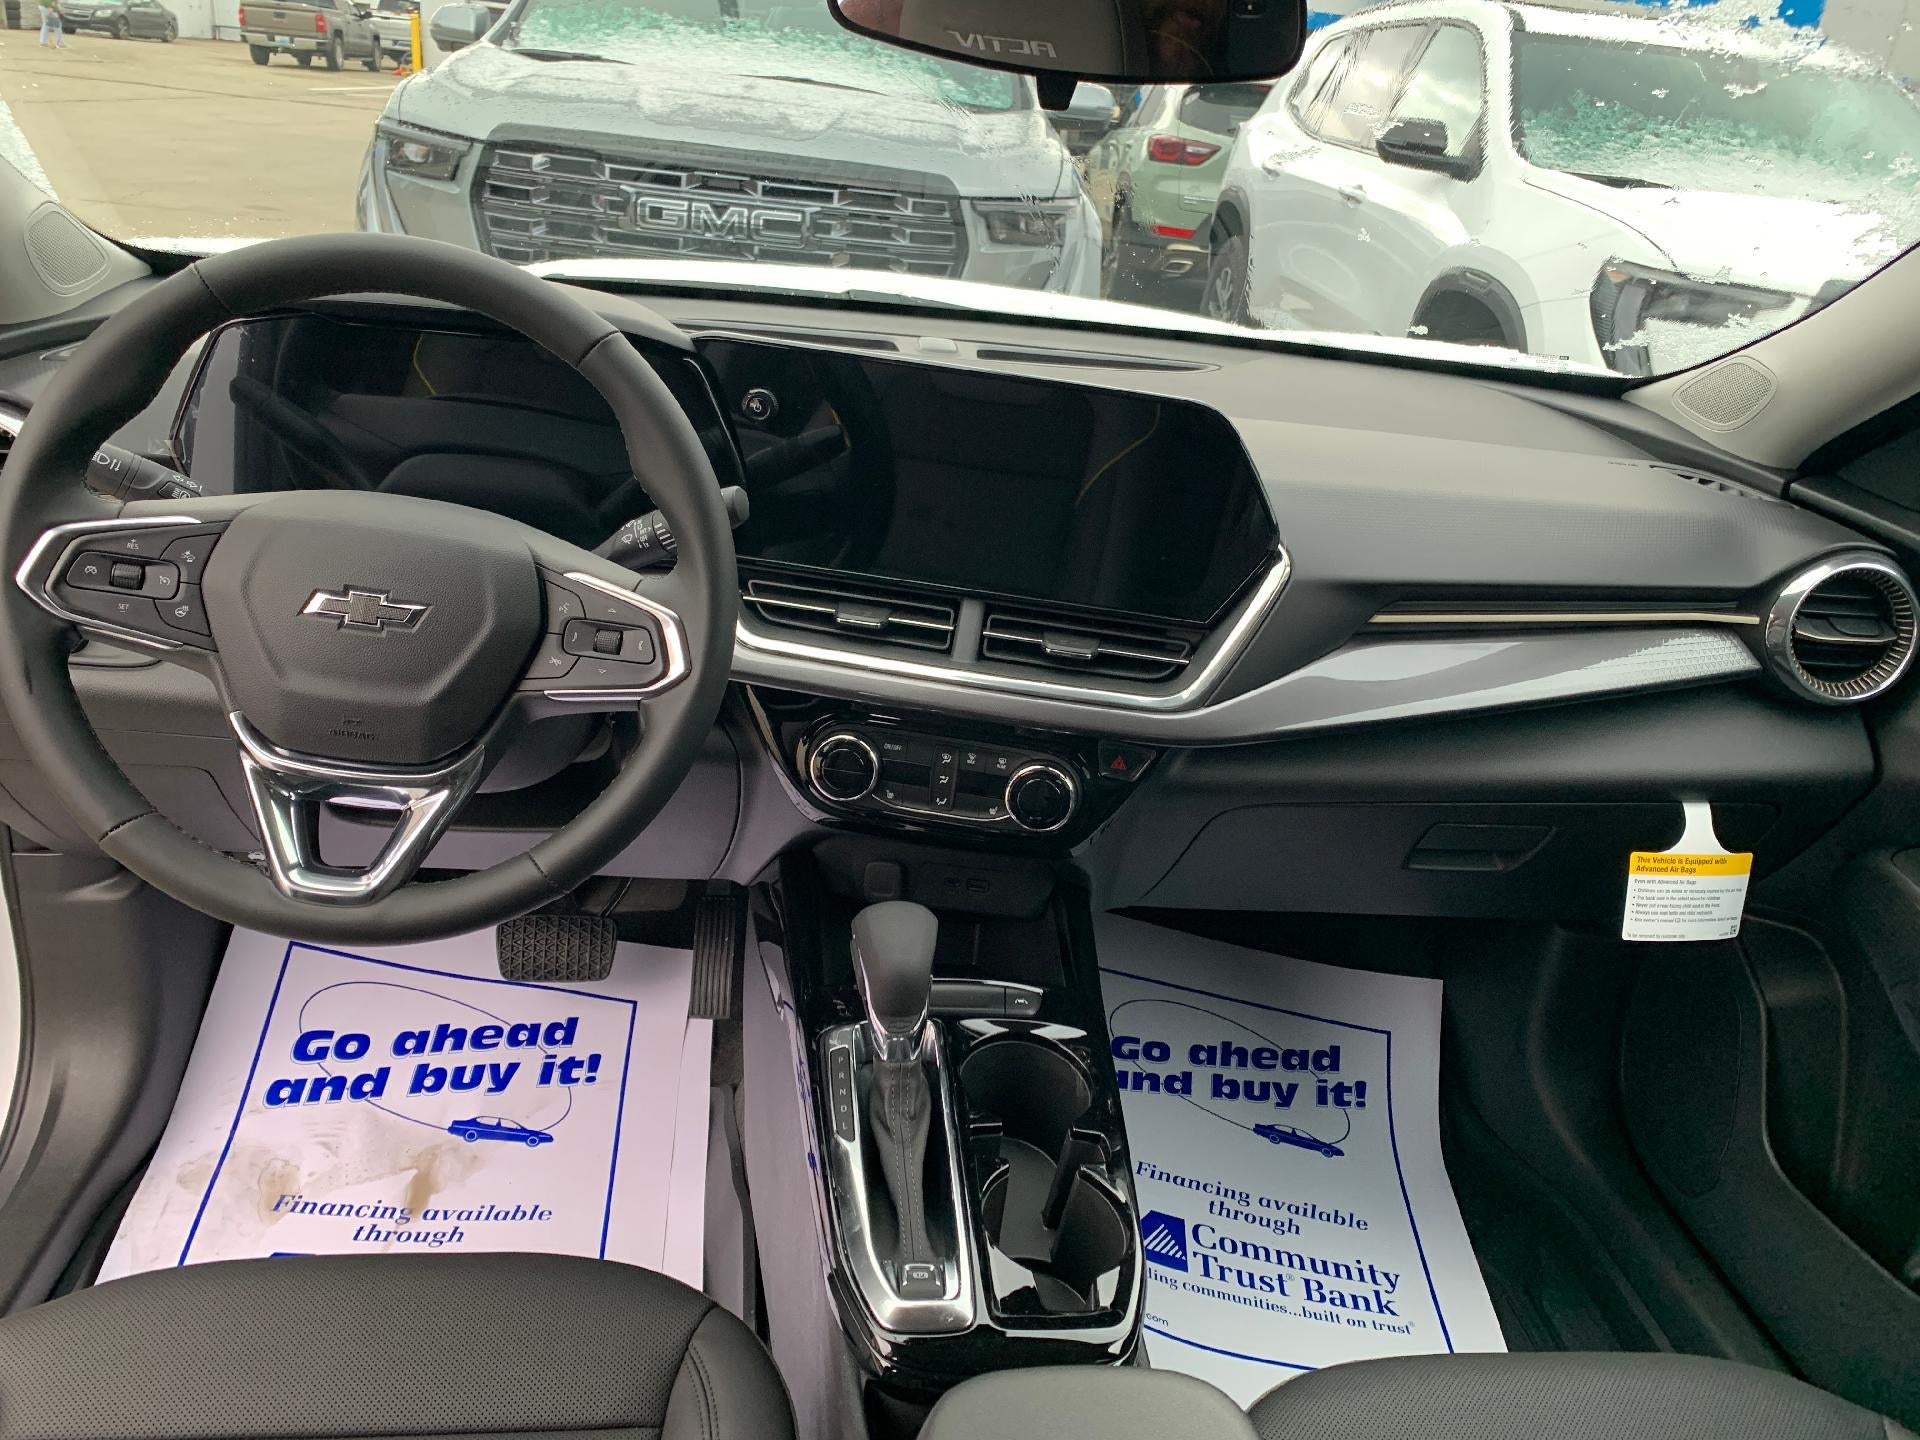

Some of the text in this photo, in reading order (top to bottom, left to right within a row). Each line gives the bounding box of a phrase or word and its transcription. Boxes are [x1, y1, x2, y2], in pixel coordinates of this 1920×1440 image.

[637, 197, 806, 249] GMC
[118, 603, 130, 611] SET
[1636, 864, 1697, 875] Advanced Air Bags
[1637, 855, 1650, 863] This
[1652, 856, 1676, 864] Vehicle
[1685, 857, 1713, 866] Equipped
[291, 1017, 579, 1064] Go ahead
[1111, 1035, 1341, 1074] Go ahead
[263, 1053, 601, 1108] and buy it!
[1211, 1073, 1299, 1109] buy
[1316, 1078, 1367, 1109] it!
[270, 1194, 552, 1224] Financing available
[1135, 1160, 1369, 1231] Financing available
[352, 1223, 464, 1248] through
[1208, 1200, 1301, 1236] through
[1191, 1223, 1400, 1294] Community
[1300, 1277, 1400, 1317] Bank
[1346, 1317, 1367, 1329] on
